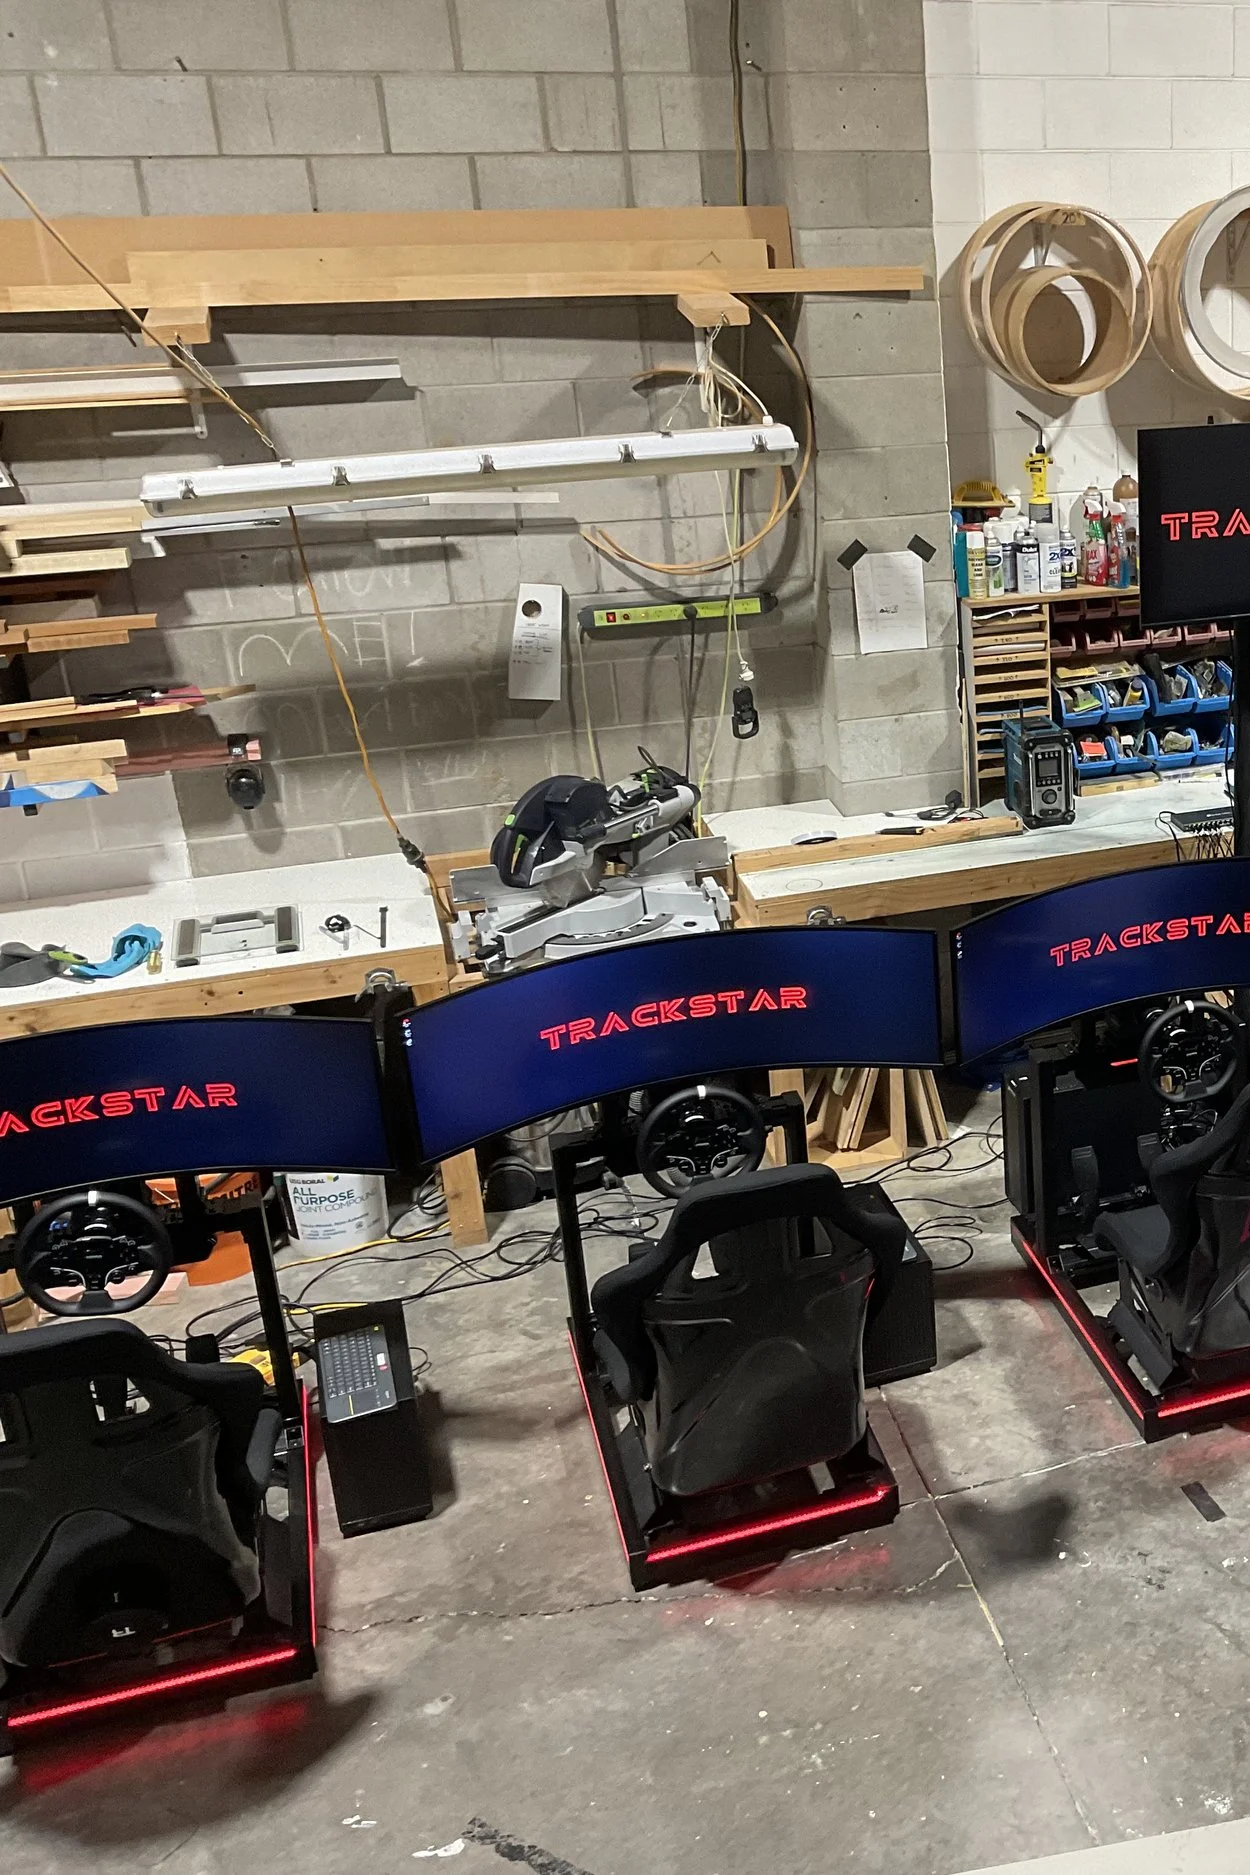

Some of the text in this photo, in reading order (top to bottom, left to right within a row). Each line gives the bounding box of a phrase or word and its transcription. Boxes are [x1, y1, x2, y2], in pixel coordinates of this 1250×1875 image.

[541, 986, 808, 1050] TRACKSTAR
[293, 1186, 317, 1196] ALL
[294, 1189, 355, 1206] PURPOSE
[296, 1205, 322, 1213] JOINT
